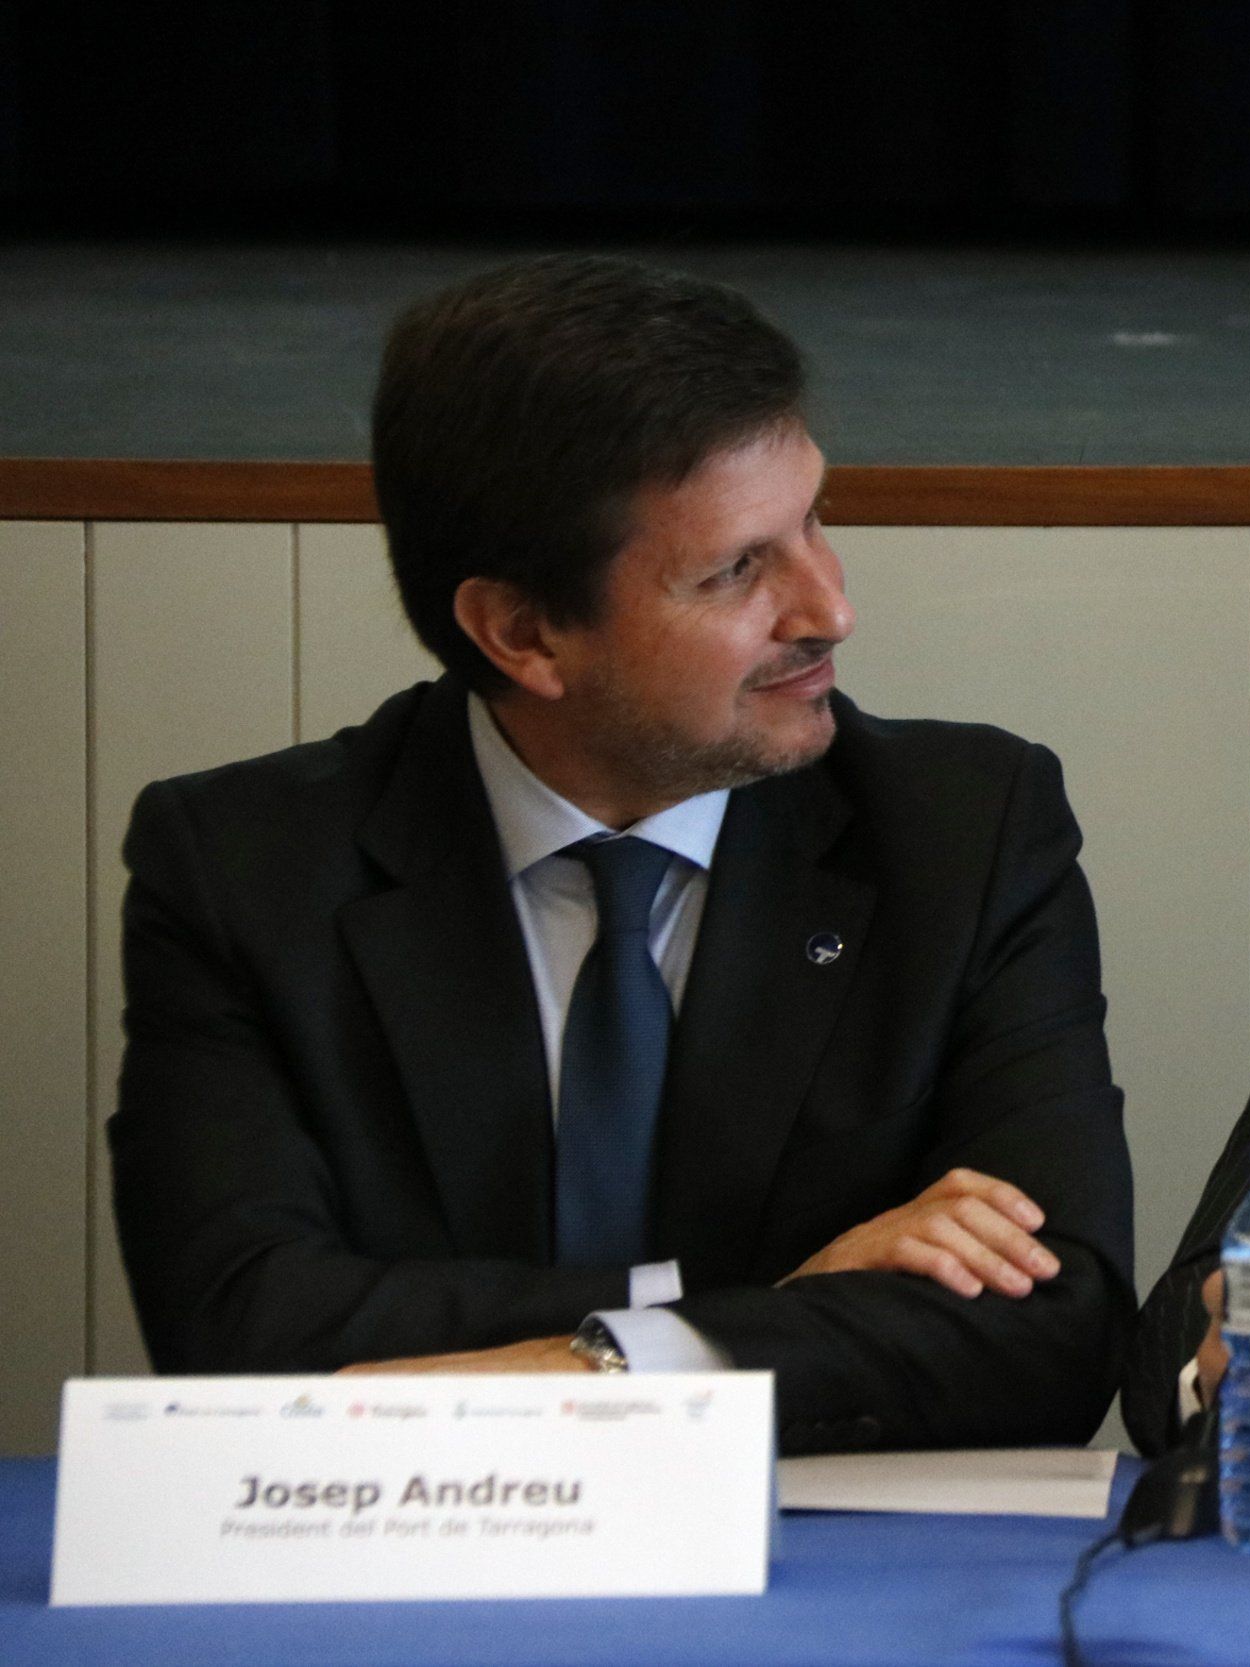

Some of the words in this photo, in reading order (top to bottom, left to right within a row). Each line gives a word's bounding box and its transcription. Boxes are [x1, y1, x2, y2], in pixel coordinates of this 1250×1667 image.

[236, 1474, 382, 1516] Josep
[399, 1473, 581, 1507] Andreu
[220, 1517, 332, 1538] President
[340, 1517, 376, 1538] del
[384, 1517, 430, 1537] Port
[439, 1516, 469, 1536] de
[481, 1517, 594, 1540] Tarragona
